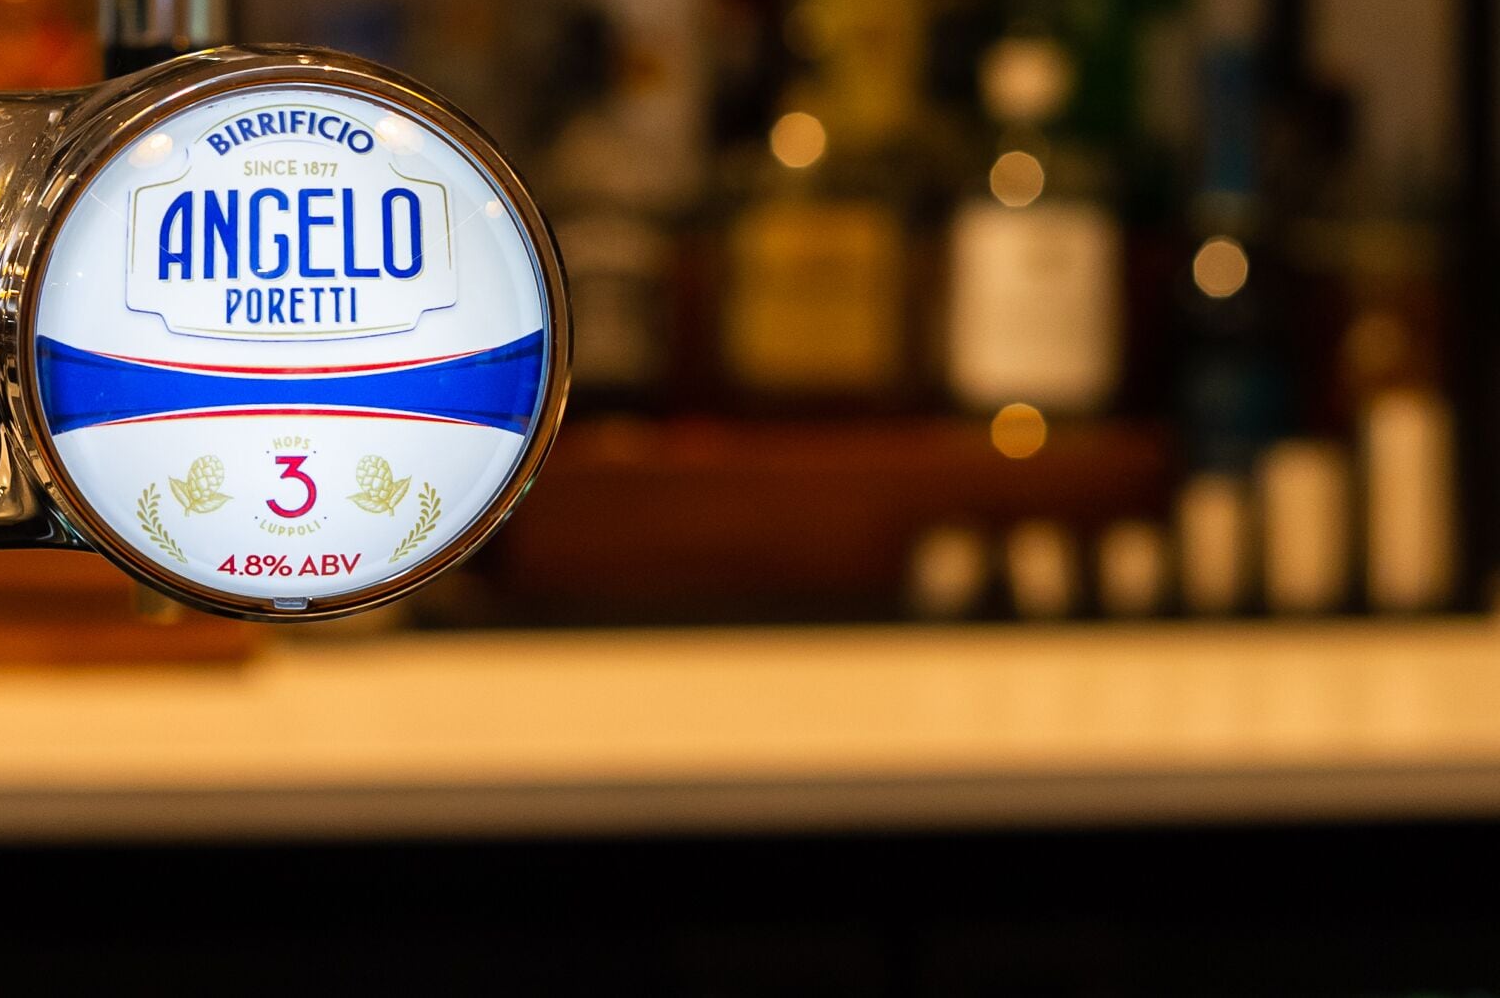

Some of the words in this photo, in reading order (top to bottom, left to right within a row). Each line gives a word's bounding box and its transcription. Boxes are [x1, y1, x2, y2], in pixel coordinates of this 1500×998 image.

[206, 111, 374, 156] BIRRIFICIO
[243, 160, 297, 177] SINCE
[303, 162, 338, 178] 1877
[158, 187, 424, 281] ANGELO
[225, 287, 357, 324] PORETTI
[272, 436, 311, 450] HOPS
[265, 455, 317, 519] 3
[259, 519, 321, 537] LUPPOLI
[216, 554, 293, 577] 4.8%
[297, 553, 362, 577] ABV
